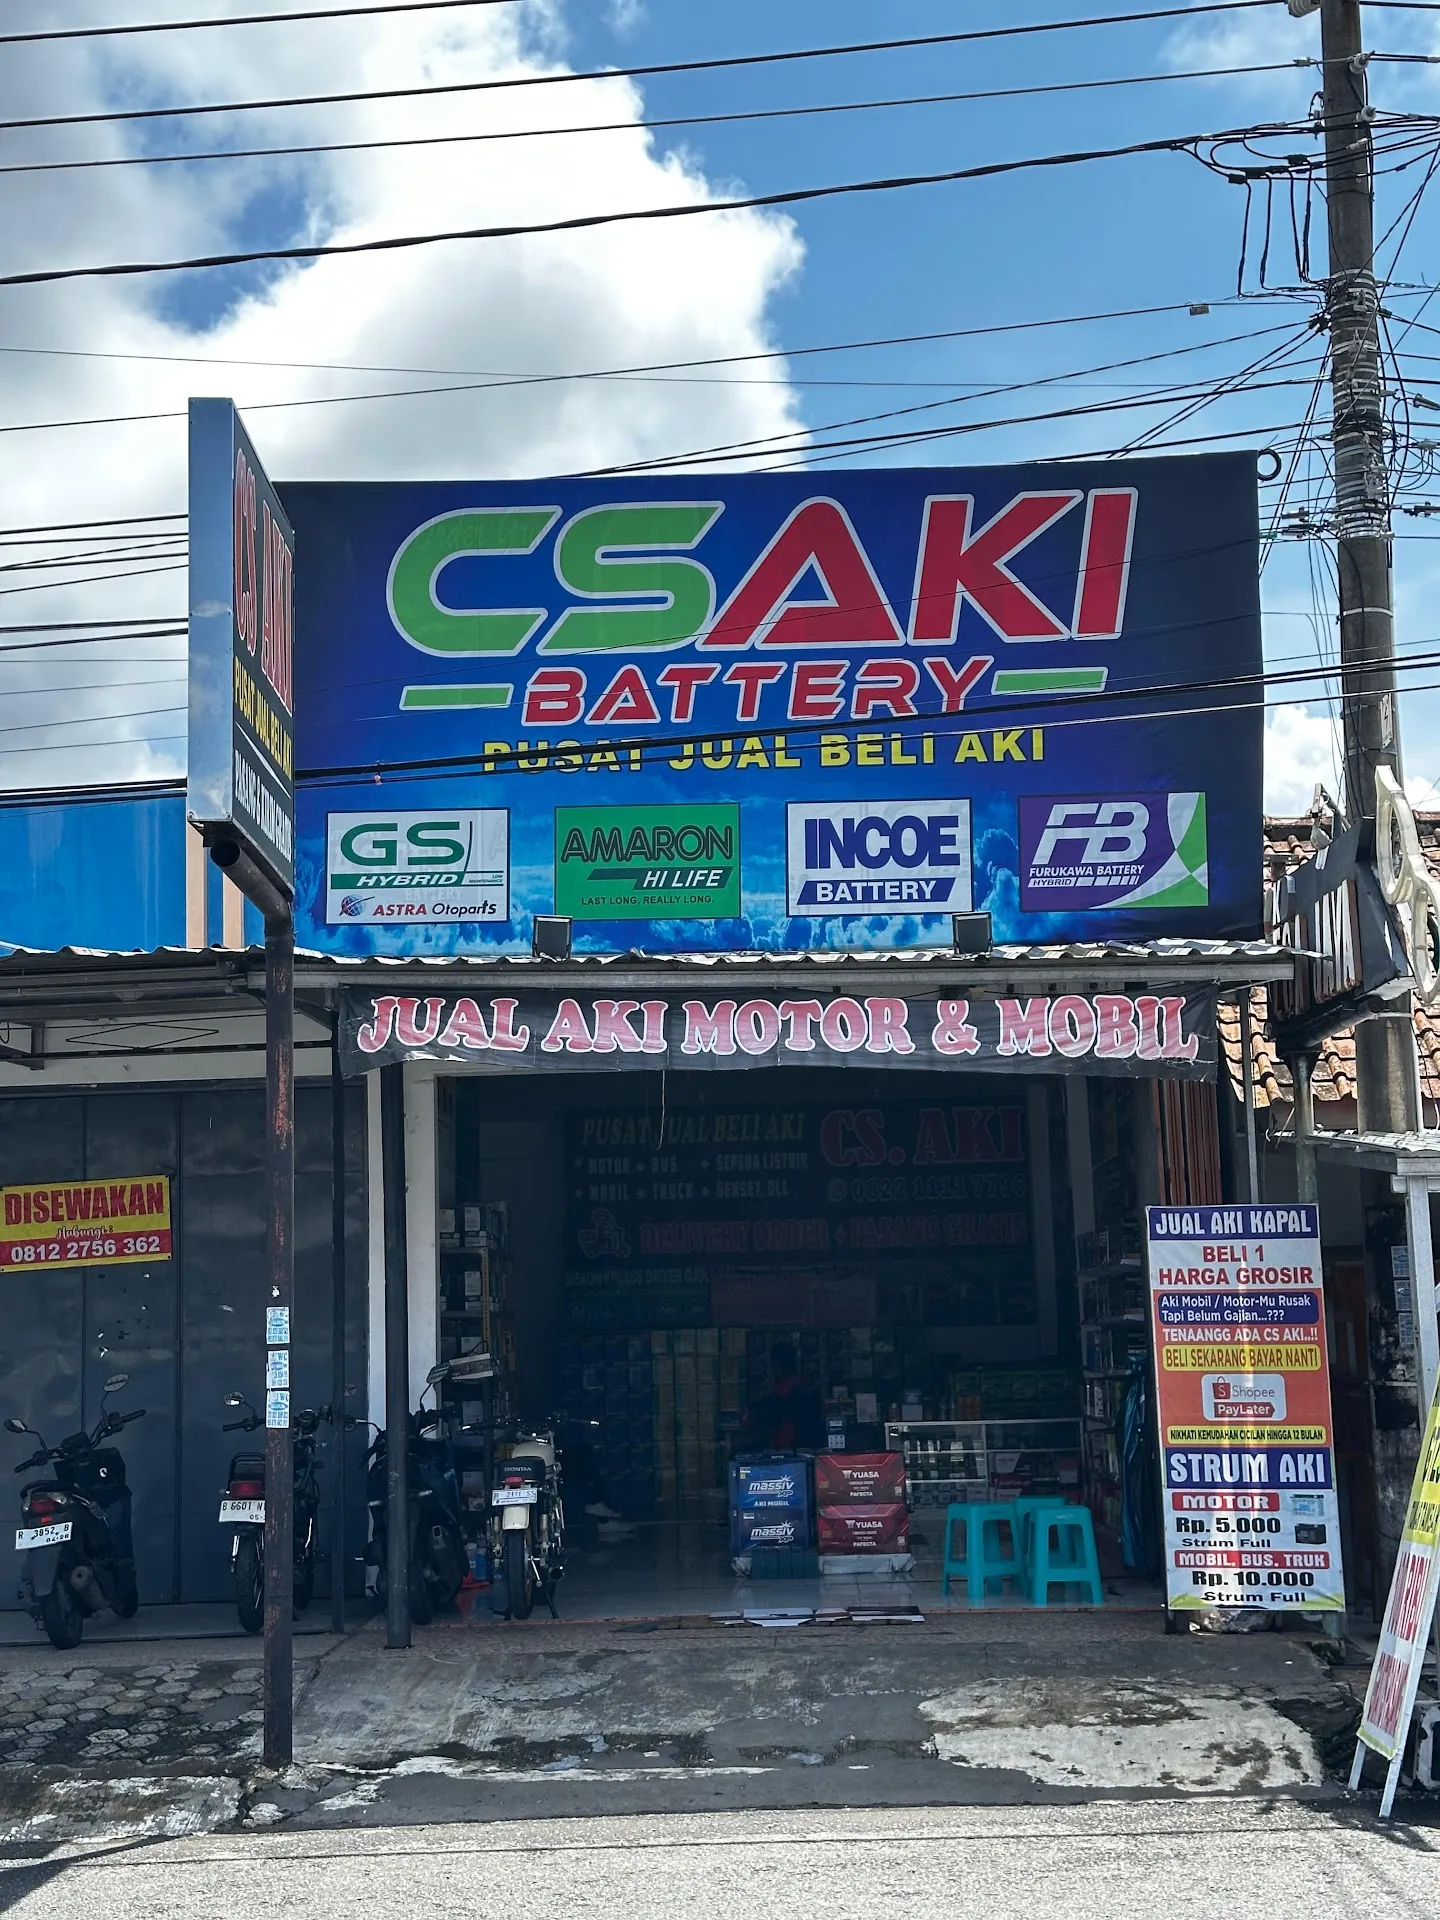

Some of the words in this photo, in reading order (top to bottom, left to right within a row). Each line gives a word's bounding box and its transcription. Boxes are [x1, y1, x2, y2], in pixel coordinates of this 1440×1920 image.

[235, 447, 257, 658] CS
[261, 500, 293, 718] AKI
[521, 655, 994, 726] BATTERY
[235, 654, 255, 728] PUSAT
[255, 688, 270, 751] JUAL
[270, 710, 283, 769] BELI
[483, 738, 651, 773] PUSAT
[668, 735, 801, 771] JUAL
[820, 732, 934, 766] BELI
[954, 728, 1044, 763] AKI
[804, 815, 960, 869] INCOE
[1032, 802, 1149, 865] FB
[340, 821, 465, 867] GS
[561, 824, 733, 864] AMARON
[642, 870, 669, 888] HI
[671, 869, 724, 887] LIFE
[1029, 866, 1093, 877] FURUKAWA
[1097, 864, 1145, 876] BATTERY
[356, 873, 458, 887] HYBRID
[1032, 878, 1072, 886] HYBRID
[816, 880, 937, 902] BATTERY
[373, 903, 427, 917] ASTRA
[432, 899, 497, 918] Otoparts
[581, 896, 607, 906] LAST
[609, 896, 640, 907] LONG,
[643, 895, 681, 905] REALLY
[684, 895, 714, 905] LONG.
[357, 996, 530, 1053] JUAL
[541, 998, 668, 1053] AKI
[681, 997, 916, 1055] MOTOR
[932, 998, 981, 1055] &
[996, 995, 1199, 1060] MOBIL
[582, 1118, 650, 1146] PUSAT
[765, 1113, 806, 1141] AKI
[913, 1106, 1025, 1164] AKI
[652, 1156, 678, 1173] BUS
[4, 1182, 164, 1226] DISEWAKAN
[1155, 1212, 1205, 1235] JUAL
[1211, 1211, 1243, 1234] AKI
[1250, 1210, 1312, 1233] KAPAL
[11, 1243, 61, 1263] 0812
[67, 1239, 117, 1259] 2756
[123, 1236, 160, 1253] 362
[1203, 1245, 1248, 1263] BELI
[1255, 1245, 1264, 1262] 1
[1159, 1267, 1230, 1285] HARGA
[1236, 1266, 1314, 1285] GROSIR
[1161, 1295, 1179, 1307] Aki
[1182, 1295, 1211, 1307] Mobil
[1224, 1295, 1275, 1307] Motor-Mu
[1278, 1294, 1311, 1306] Rusak
[1162, 1310, 1184, 1323] Tapi
[1188, 1309, 1221, 1321] Belum
[1163, 1328, 1231, 1342] TENAANGG
[1234, 1327, 1261, 1341] ADA
[1263, 1327, 1280, 1341] CS
[1166, 1349, 1188, 1367] BELI
[1191, 1349, 1246, 1367] SEKARANG
[1250, 1348, 1283, 1367] BAYAR
[1286, 1348, 1318, 1367] NANTI
[1232, 1385, 1275, 1402] Shopee
[1217, 1403, 1270, 1417] PayLater
[1170, 1430, 1197, 1440] NIKMATI
[1198, 1429, 1239, 1440] KEMUDAHAN
[1239, 1429, 1266, 1440] CICILAN
[1267, 1429, 1291, 1440] HINGGA
[1292, 1429, 1300, 1440] 12
[1300, 1429, 1323, 1440] BULAN
[852, 1471, 879, 1479] YUASA
[1170, 1453, 1269, 1483] STRUM
[1279, 1453, 1325, 1483] AKI
[749, 1481, 794, 1491] massiv
[222, 1501, 227, 1511] B
[1182, 1495, 1269, 1509] MOTOR
[751, 1527, 795, 1536] massiv
[856, 1520, 883, 1529] YUASA
[1176, 1517, 1211, 1534] Rp.
[1216, 1517, 1281, 1533] 5.000
[18, 1531, 24, 1539] R
[1182, 1538, 1234, 1547] Strum
[1240, 1539, 1271, 1547] Full
[1284, 1554, 1325, 1567] TRUK
[1192, 1571, 1228, 1587] Rp.
[1233, 1571, 1314, 1587] 10.000
[1204, 1591, 1267, 1602] Strum
[1271, 1592, 1306, 1602] Full
